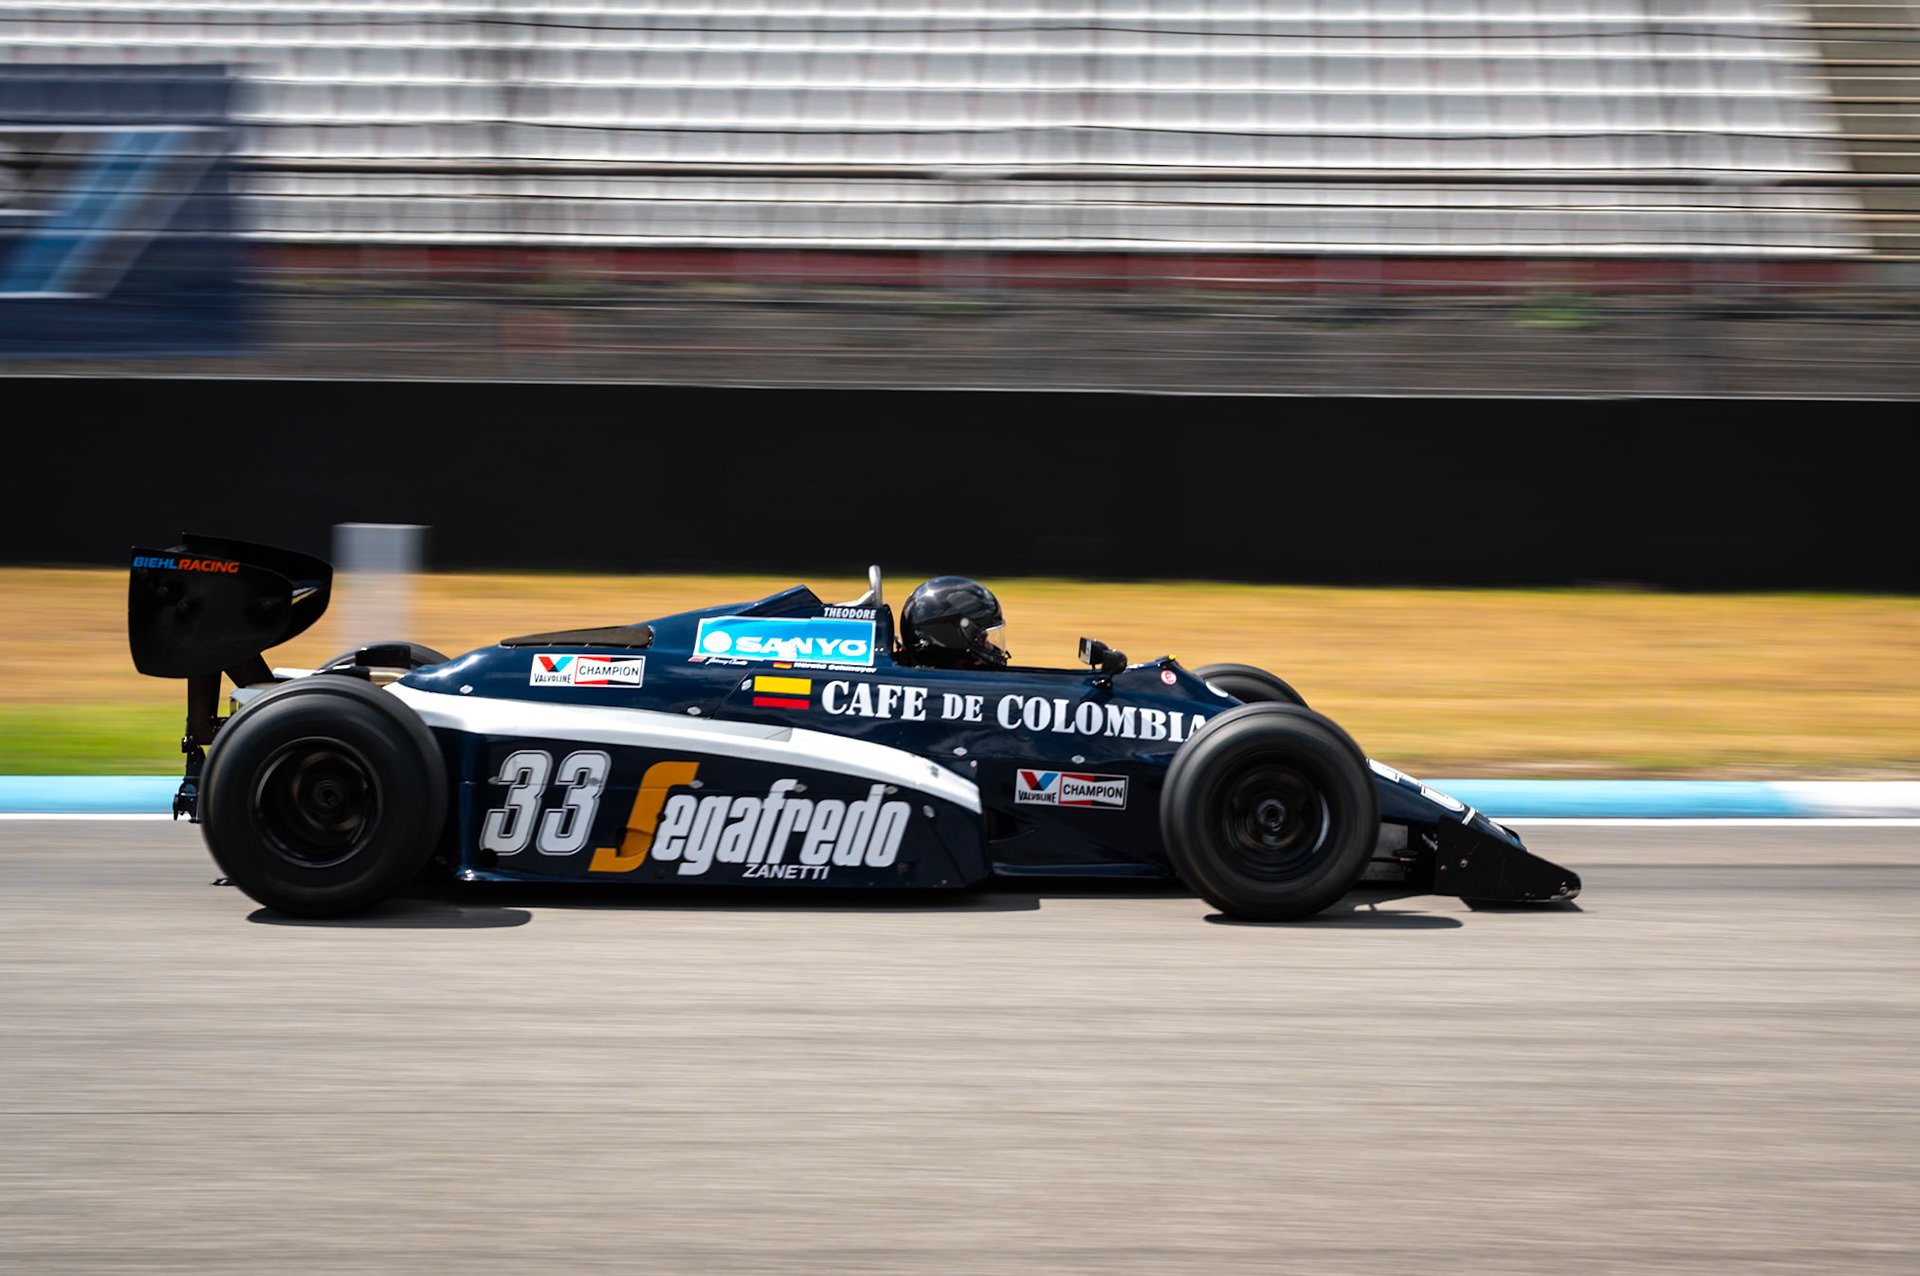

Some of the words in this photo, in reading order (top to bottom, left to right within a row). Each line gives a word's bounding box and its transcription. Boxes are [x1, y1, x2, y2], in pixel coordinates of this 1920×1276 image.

[823, 607, 877, 620] THEODORE
[736, 636, 868, 657] SANYO
[534, 673, 572, 684] VALVOLINE
[579, 665, 639, 677] CHAMPION
[821, 680, 928, 721] CAFE
[941, 693, 984, 722] DE
[996, 694, 1207, 743] COLOMBIA
[479, 750, 612, 857] 33
[1018, 790, 1057, 804] VALVOLINE
[1062, 783, 1123, 798] CHAMPION
[588, 761, 912, 876] Segafredo
[742, 862, 831, 880] ZANETTI
